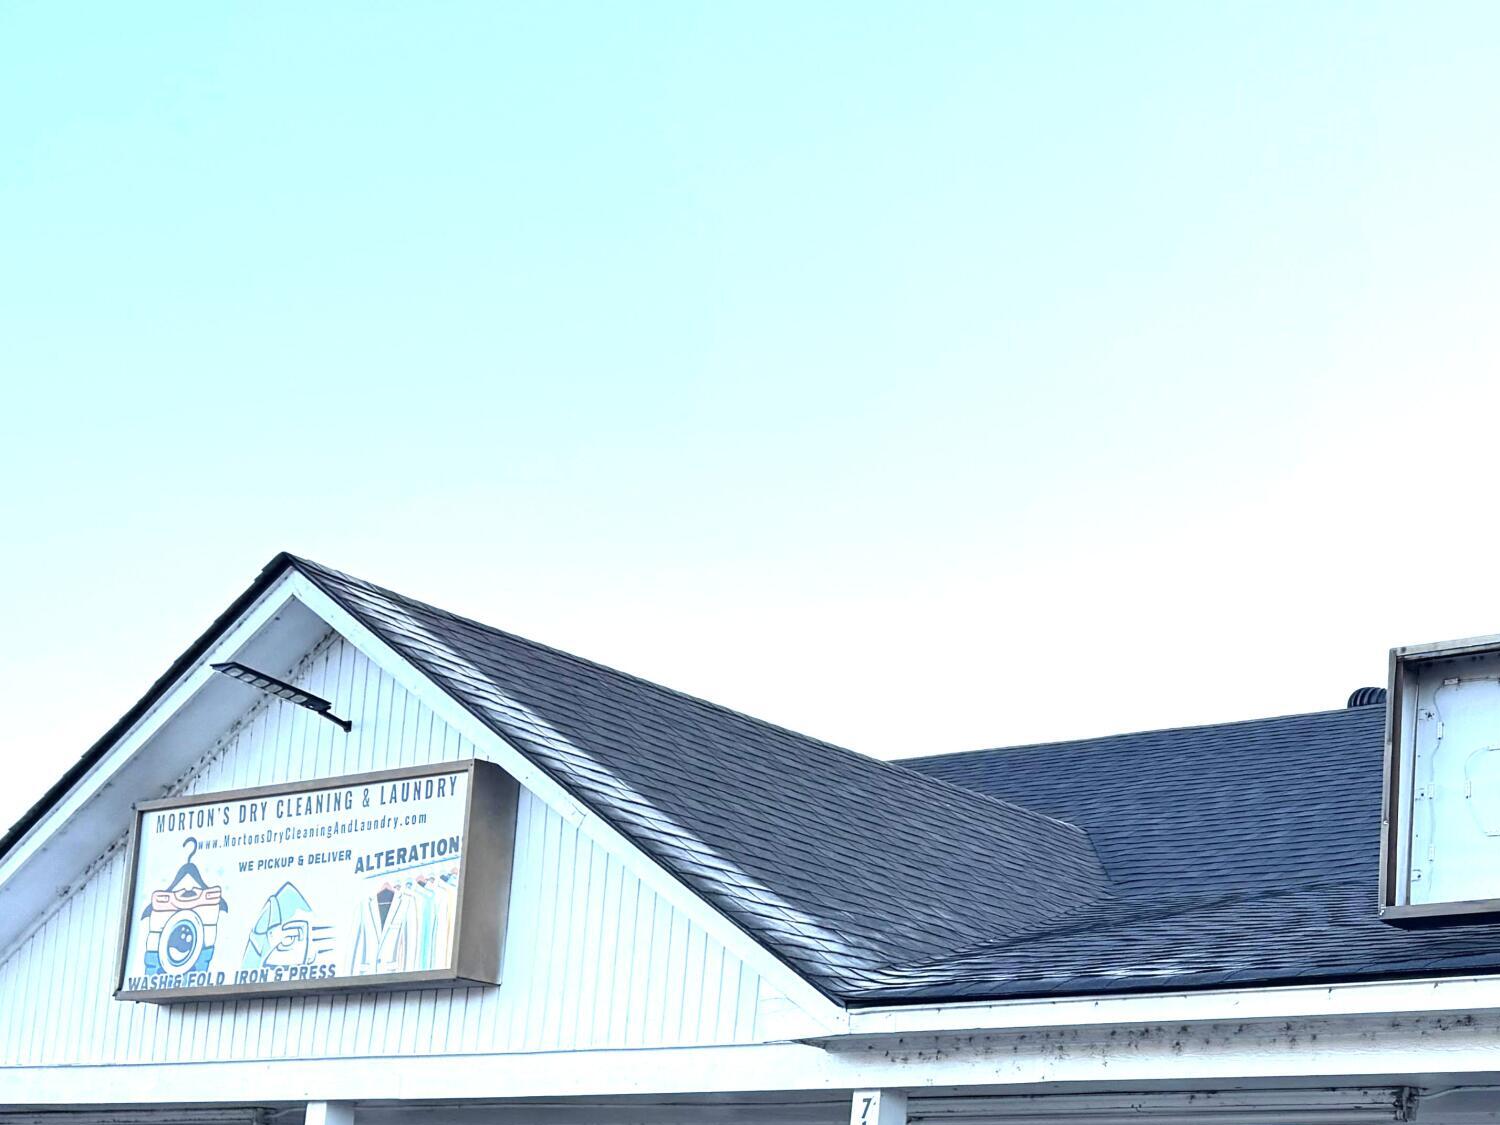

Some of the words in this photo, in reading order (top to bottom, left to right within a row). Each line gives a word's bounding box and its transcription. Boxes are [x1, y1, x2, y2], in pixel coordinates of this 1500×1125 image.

[156, 806, 230, 834] MORTON'S
[239, 801, 268, 824] DRY
[276, 791, 353, 819] CLEANING
[362, 788, 370, 808] &
[380, 776, 458, 806] LAUNDRY
[239, 860, 254, 873] WE
[257, 856, 294, 871] PICKUP
[297, 855, 305, 866] &
[308, 850, 352, 865] DELIVER
[354, 835, 461, 874] ALTERATION
[128, 973, 171, 991] WASH
[187, 970, 225, 987] FOLD
[234, 967, 269, 985] IRON
[274, 967, 283, 982] &
[288, 964, 336, 980] PRESS
